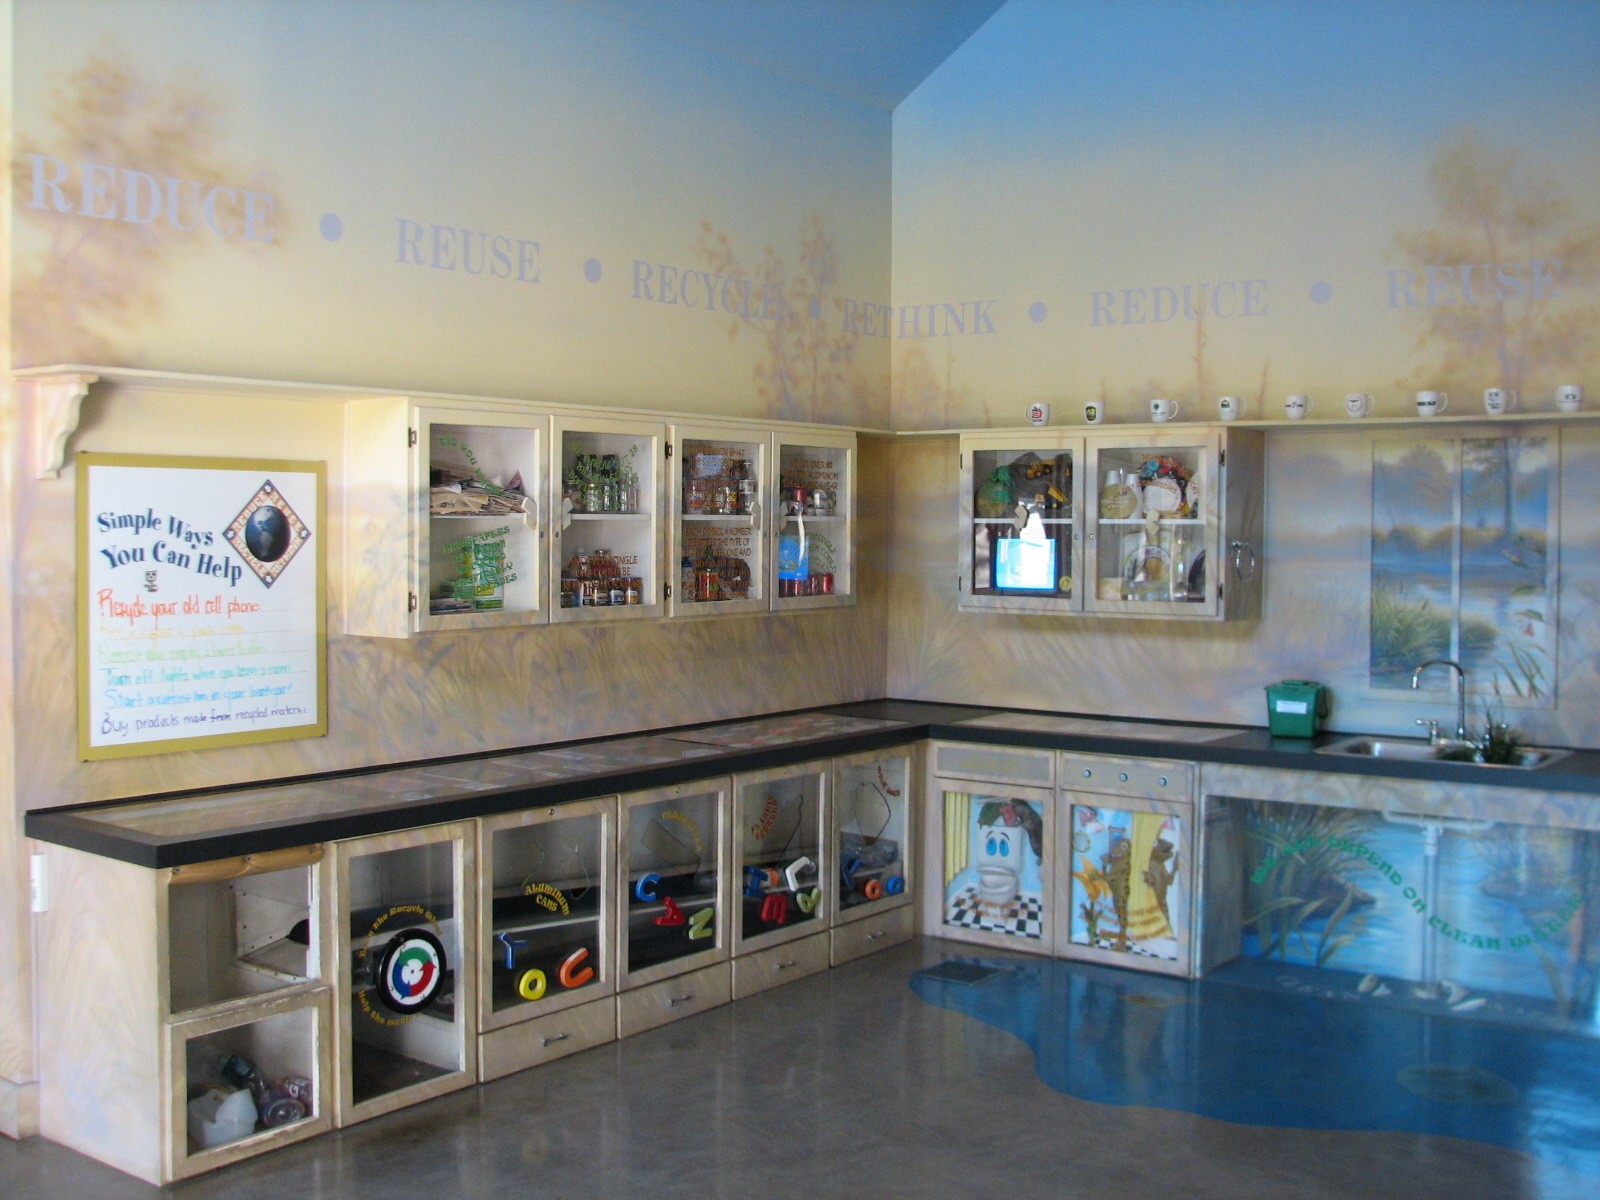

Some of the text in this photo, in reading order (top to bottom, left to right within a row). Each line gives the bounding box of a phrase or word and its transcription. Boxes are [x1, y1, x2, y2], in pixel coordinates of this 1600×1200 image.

[28, 152, 1564, 339] REDUCE REUSE RECYCLE RETHINK REDUCE REUSE
[97, 508, 214, 550] Simple Ways
[100, 540, 243, 588] You Can Help
[151, 601, 179, 627] your
[183, 594, 200, 615] old
[205, 595, 222, 615] cell
[228, 596, 261, 619] phone
[101, 711, 129, 737] Buy
[183, 715, 208, 725] made
[209, 708, 232, 724] from
[1403, 886, 1428, 914] ON
[1428, 914, 1501, 951] CLEAN
